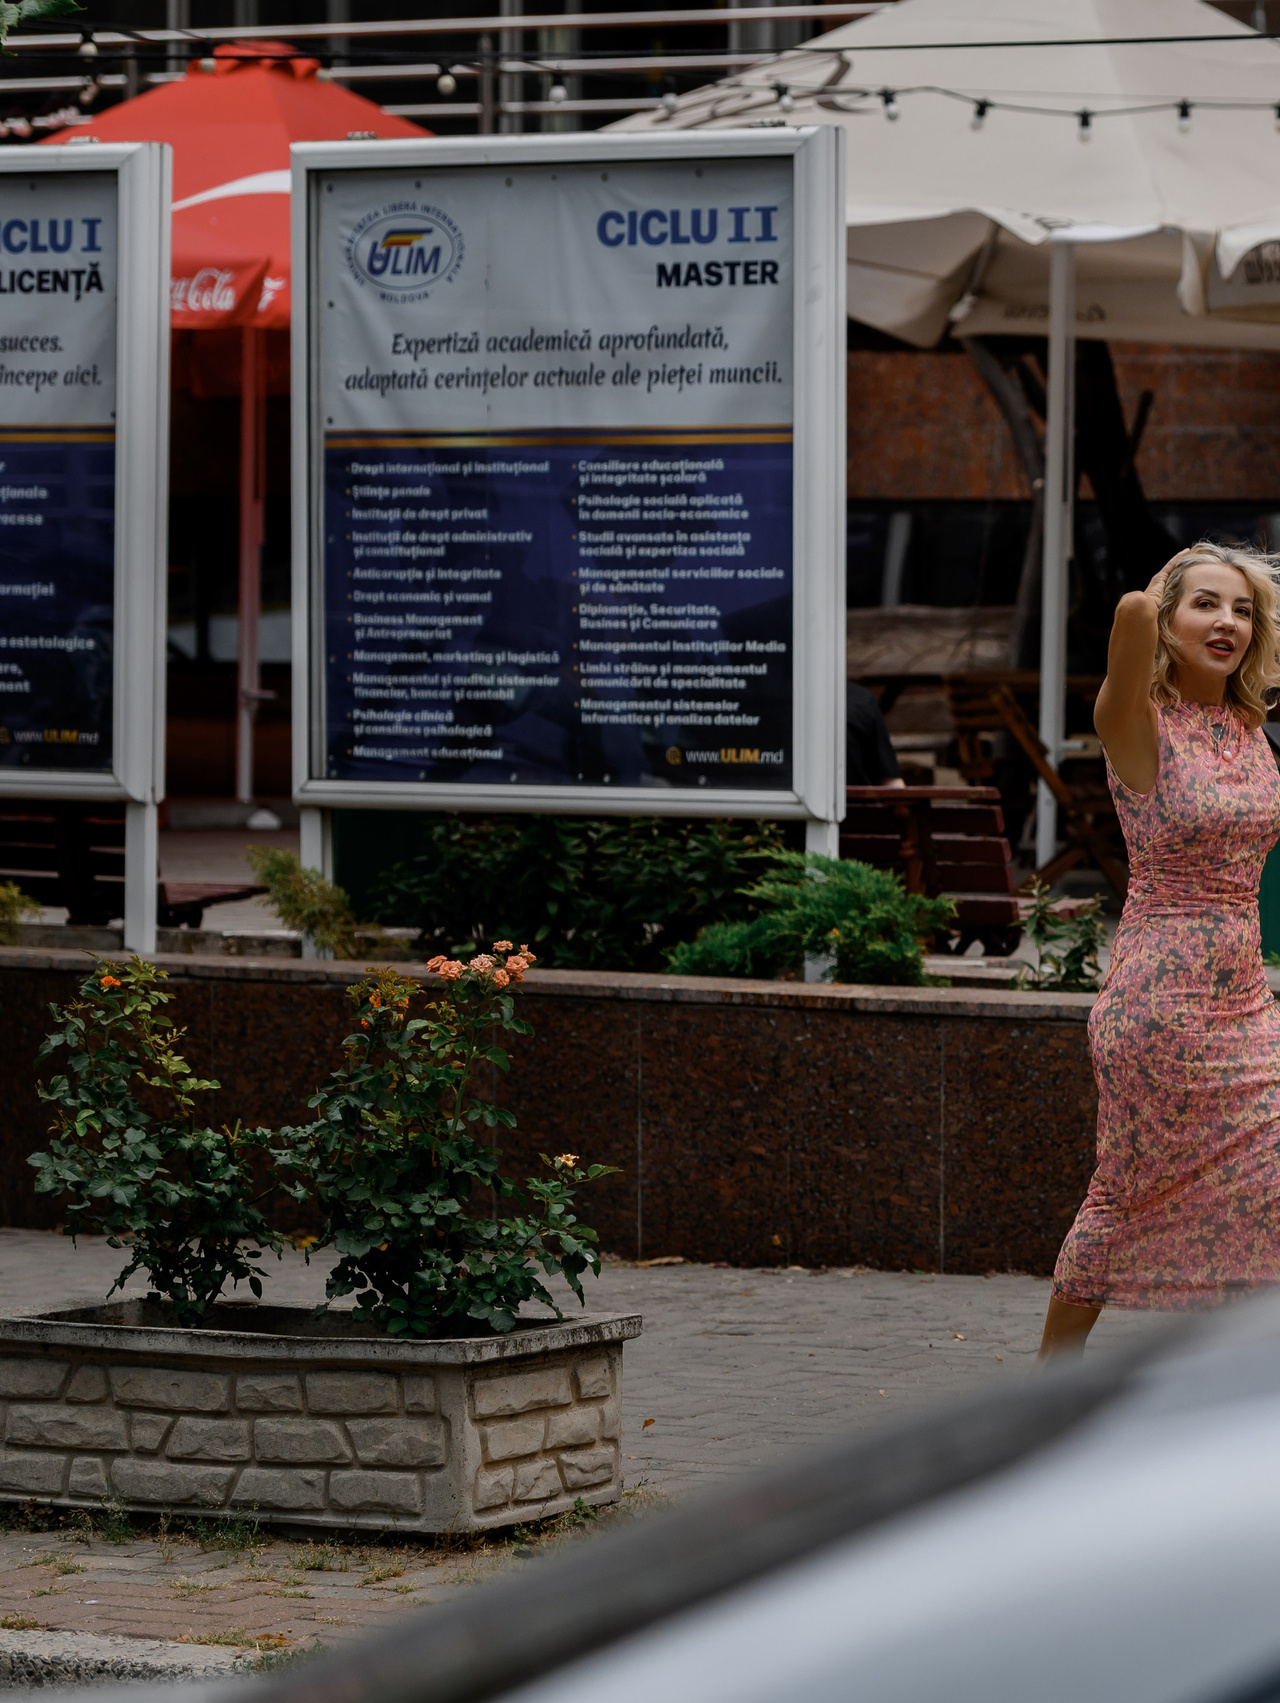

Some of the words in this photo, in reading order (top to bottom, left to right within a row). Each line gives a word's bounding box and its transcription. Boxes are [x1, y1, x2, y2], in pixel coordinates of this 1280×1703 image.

[597, 208, 718, 247] CICLU
[728, 206, 779, 243] II
[0, 218, 72, 254] CLU
[81, 217, 102, 253] I
[367, 240, 442, 277] ULIM
[655, 260, 780, 288] MASTER
[0, 335, 63, 353] succes.
[392, 332, 480, 362] Expertiză
[486, 327, 591, 353] academică
[598, 324, 728, 362] aprofundată,
[63, 363, 102, 386] aici.
[345, 364, 428, 398] adaptată
[434, 364, 528, 394] cerințelor
[534, 362, 606, 387] actuale
[612, 361, 640, 386] ale
[647, 363, 702, 393] pieței
[710, 360, 783, 384] muncii.
[579, 473, 590, 486] și
[579, 509, 590, 519] în
[676, 531, 688, 541] în
[625, 546, 636, 559] și
[580, 582, 590, 595] și
[592, 582, 607, 592] de
[630, 617, 641, 631] și
[660, 663, 671, 676] și
[653, 677, 668, 688] de
[654, 713, 664, 727] și
